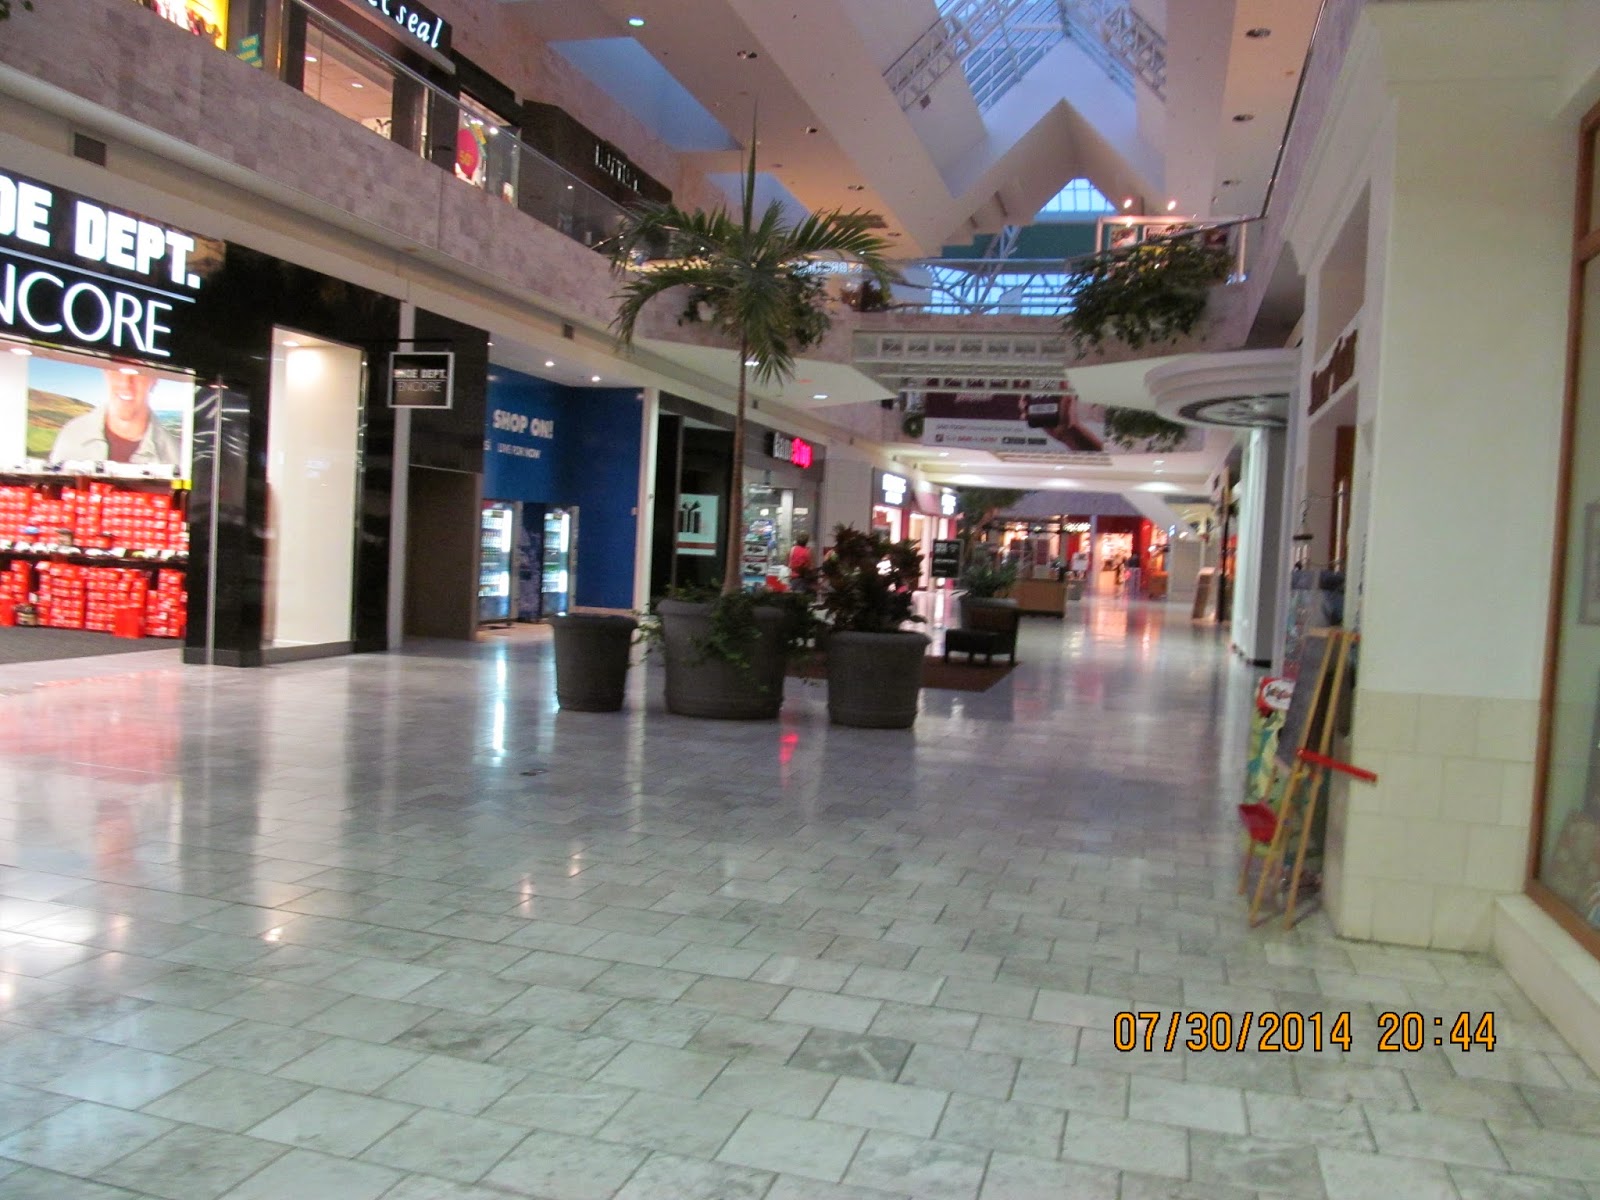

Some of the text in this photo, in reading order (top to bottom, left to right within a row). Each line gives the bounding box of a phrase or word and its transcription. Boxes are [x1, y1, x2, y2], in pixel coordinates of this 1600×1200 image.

[395, 5, 443, 48] seal
[74, 200, 201, 289] DEPT.
[492, 408, 528, 434] SHOP
